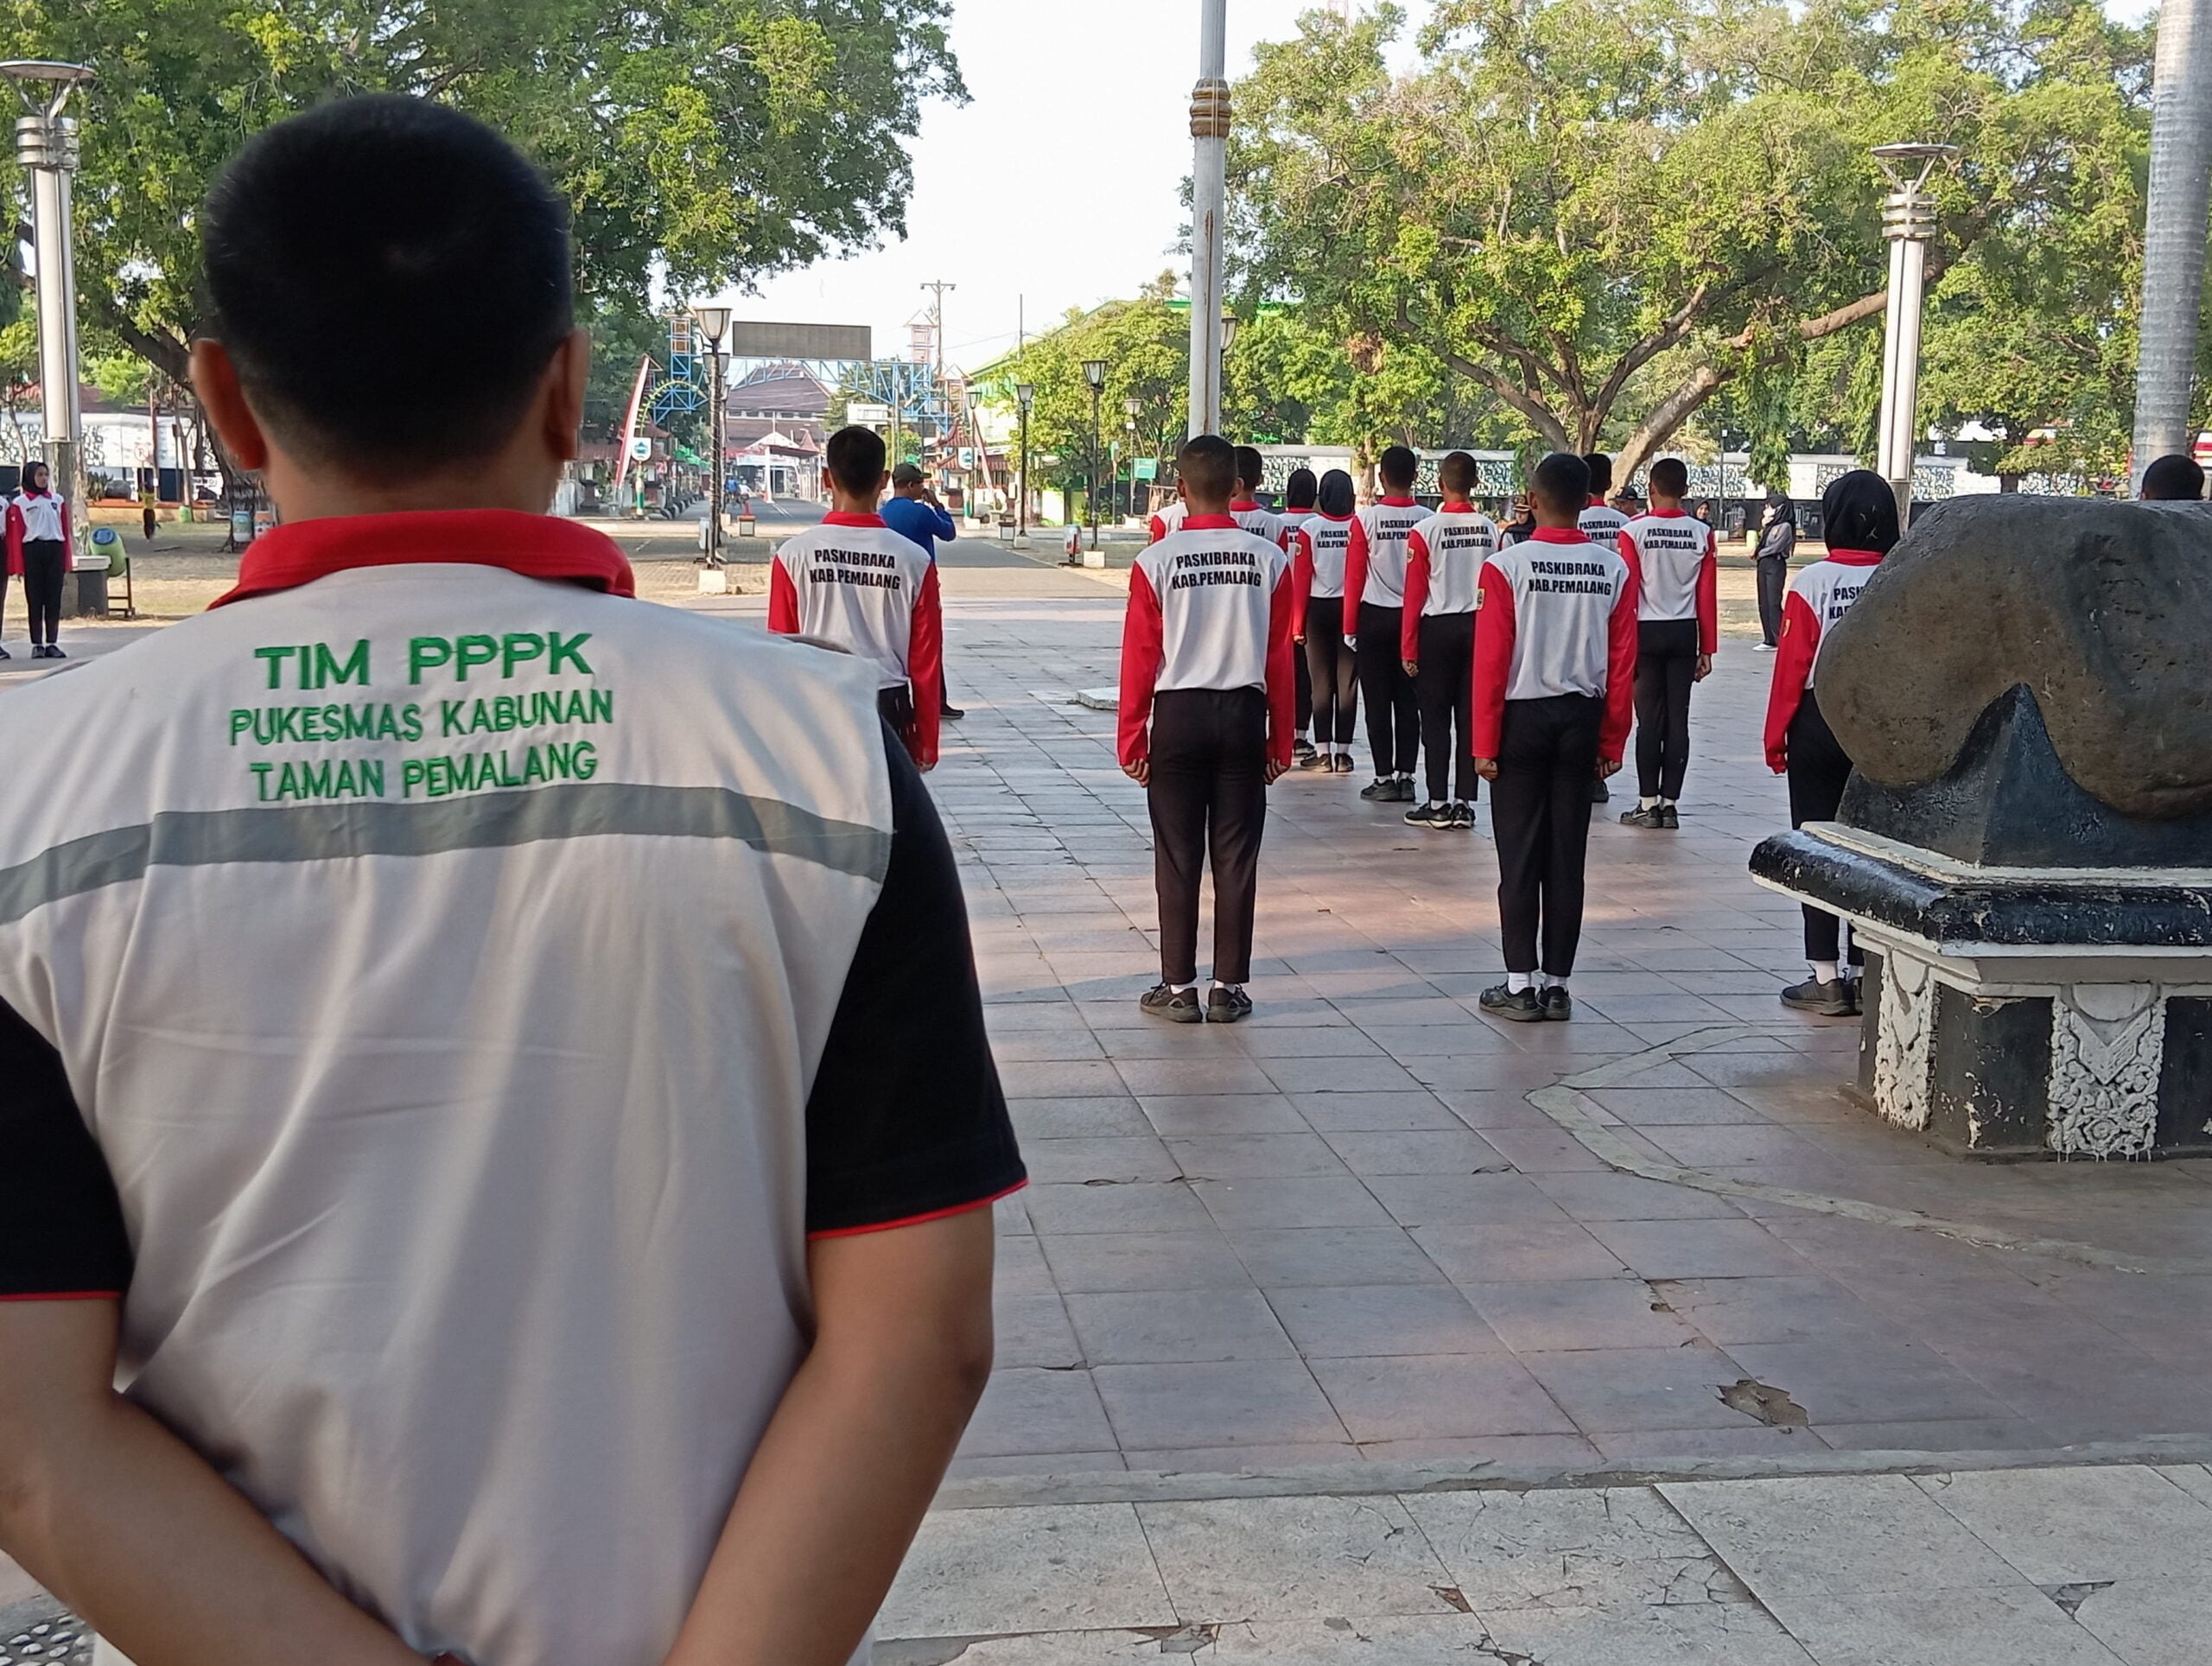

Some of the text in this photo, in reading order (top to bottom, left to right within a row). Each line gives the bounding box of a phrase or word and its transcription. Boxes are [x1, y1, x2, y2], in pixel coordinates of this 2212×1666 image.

[1443, 525, 1489, 537] PASKIBRAKA
[1647, 528, 1693, 538] PASKIBRAKA
[814, 550, 895, 569] PASKIBRAKA
[1175, 551, 1255, 569] PASKIBRAKA
[1531, 561, 1605, 577] PASKIBRAKA
[254, 632, 594, 690] TIM PPPK
[229, 689, 613, 746] PUKESMAS KABUNAN
[250, 740, 598, 802] TAMAN PEMALANG
